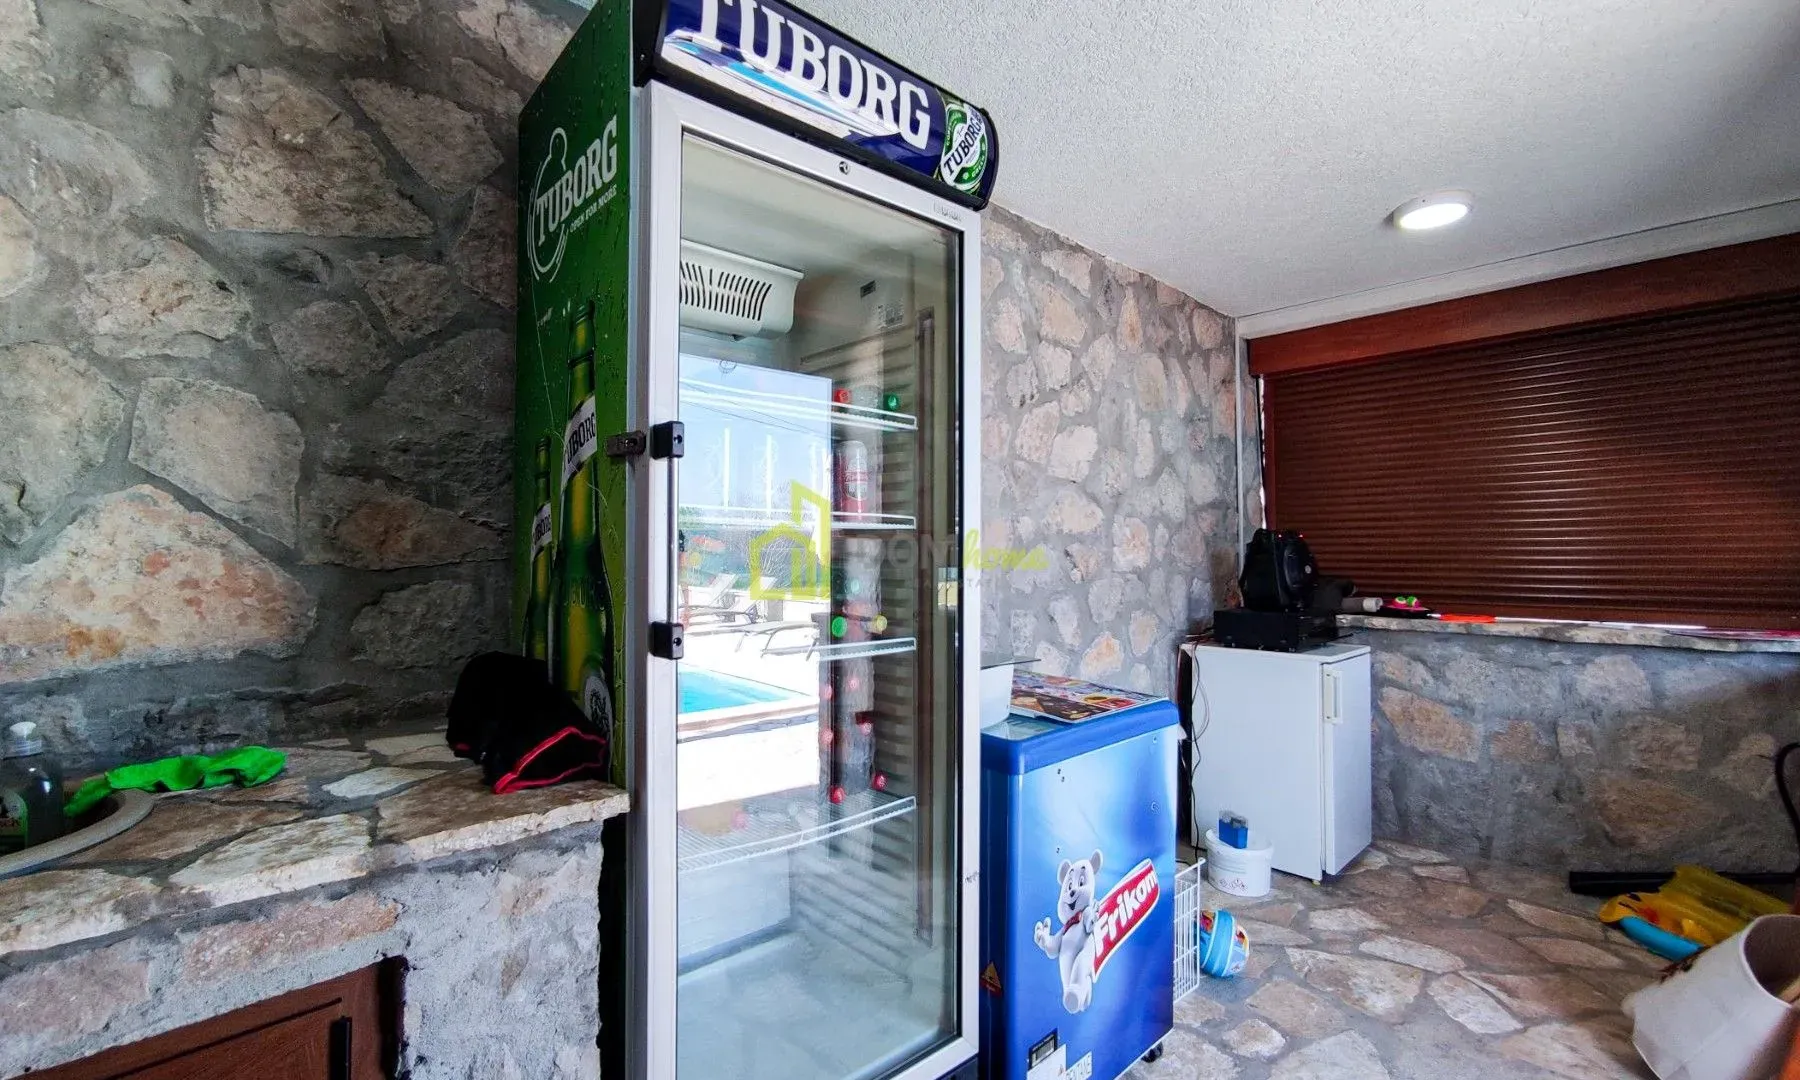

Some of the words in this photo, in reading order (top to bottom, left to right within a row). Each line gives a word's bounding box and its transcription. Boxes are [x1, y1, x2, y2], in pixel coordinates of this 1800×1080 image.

[699, 0, 931, 150] TUBORG
[536, 114, 617, 247] TUBORG
[944, 115, 982, 175] TUBORG
